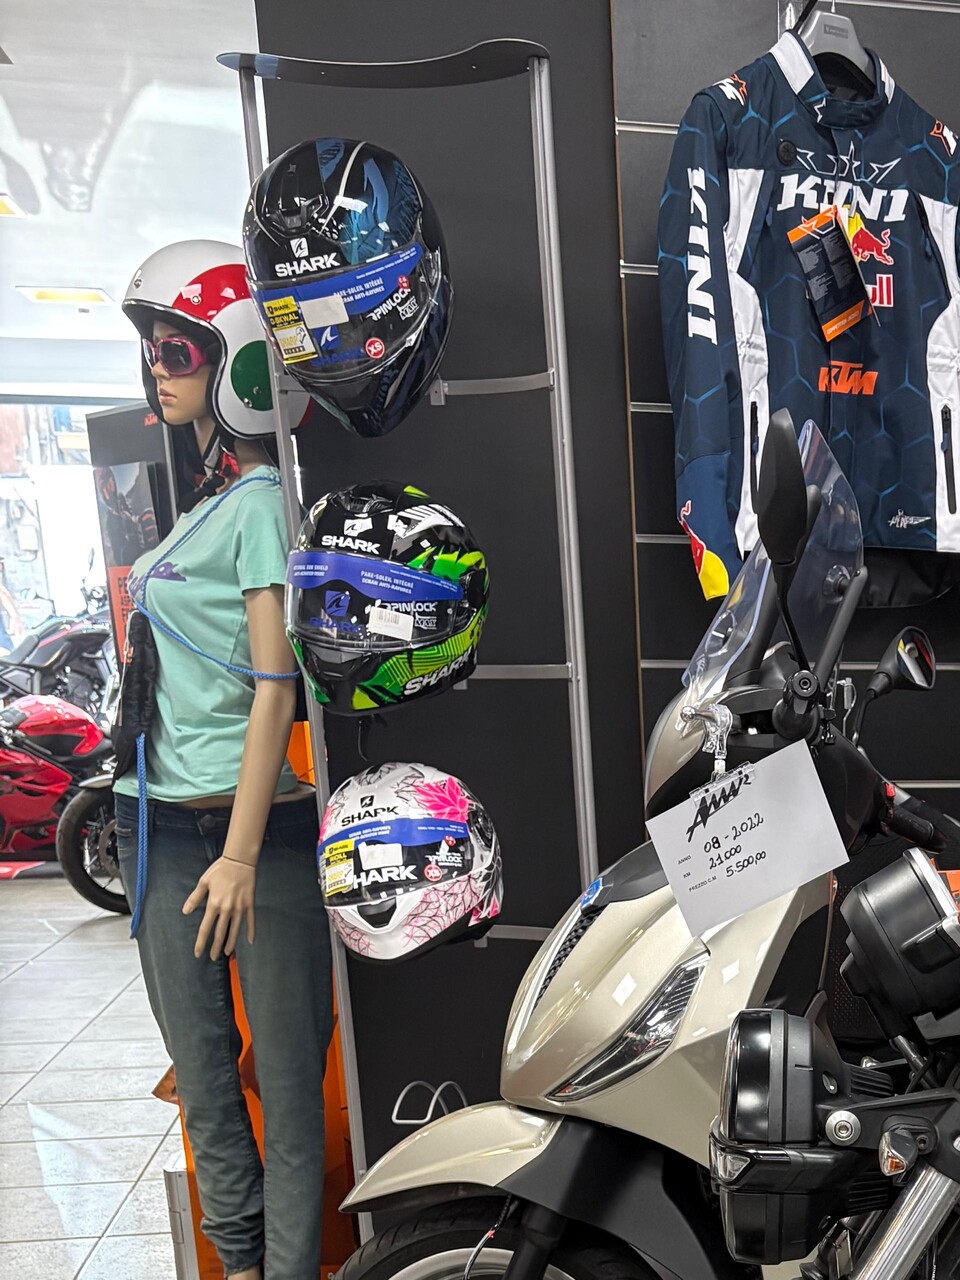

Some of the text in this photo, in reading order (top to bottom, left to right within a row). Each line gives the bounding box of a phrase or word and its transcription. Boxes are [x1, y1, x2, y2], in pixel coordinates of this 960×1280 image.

[274, 252, 341, 278] SHARK
[368, 341, 383, 356] XS
[818, 360, 878, 396] KTM
[321, 535, 381, 555] SHARK
[403, 645, 472, 696] SHARK
[341, 805, 399, 827] SHARK
[678, 854, 692, 865] ANNO
[704, 836, 721, 853] 08
[732, 812, 764, 841] 2022
[683, 844, 742, 879] KM 21.000
[688, 880, 708, 893] PREZZO
[726, 850, 767, 878] 5.500,00
[354, 865, 418, 890] HARK
